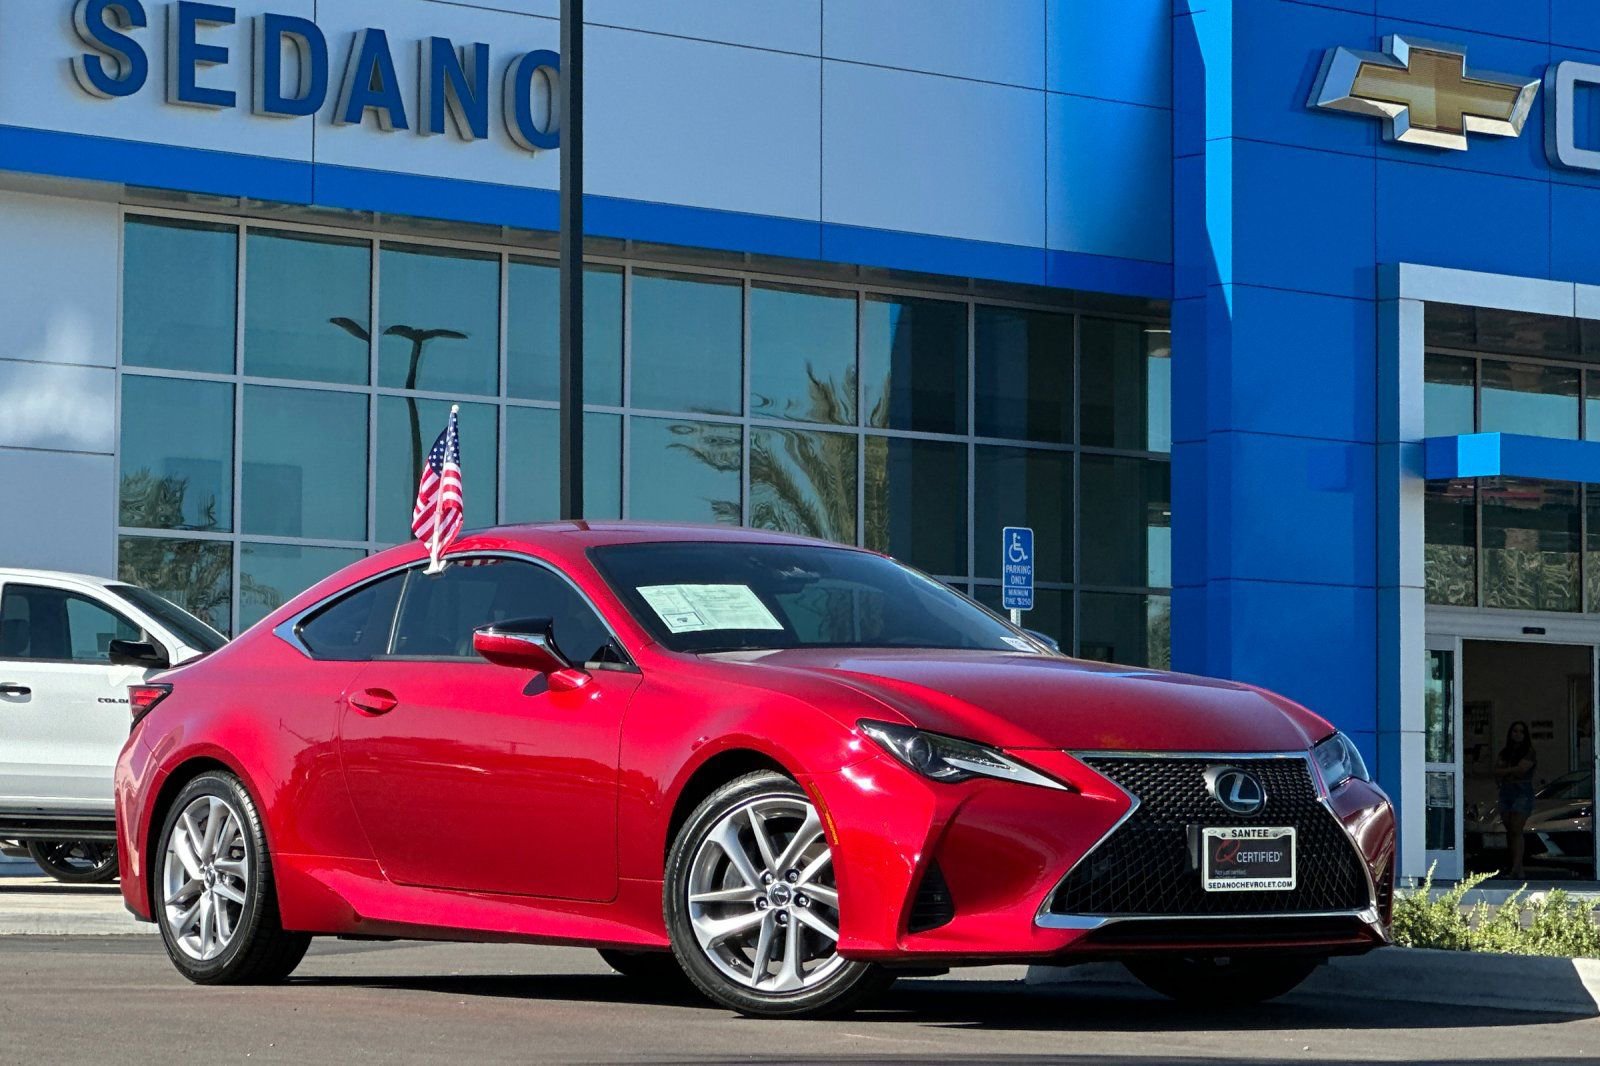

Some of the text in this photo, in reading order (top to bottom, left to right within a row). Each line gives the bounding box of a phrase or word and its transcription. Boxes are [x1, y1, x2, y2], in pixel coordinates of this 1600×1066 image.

[73, 0, 561, 152] SEDANO
[1006, 565, 1031, 575] PARKING
[1011, 576, 1026, 585] ONLY
[1231, 829, 1269, 838] SANTEE
[1208, 881, 1293, 889] SEDANOCHEVROLET.COM
